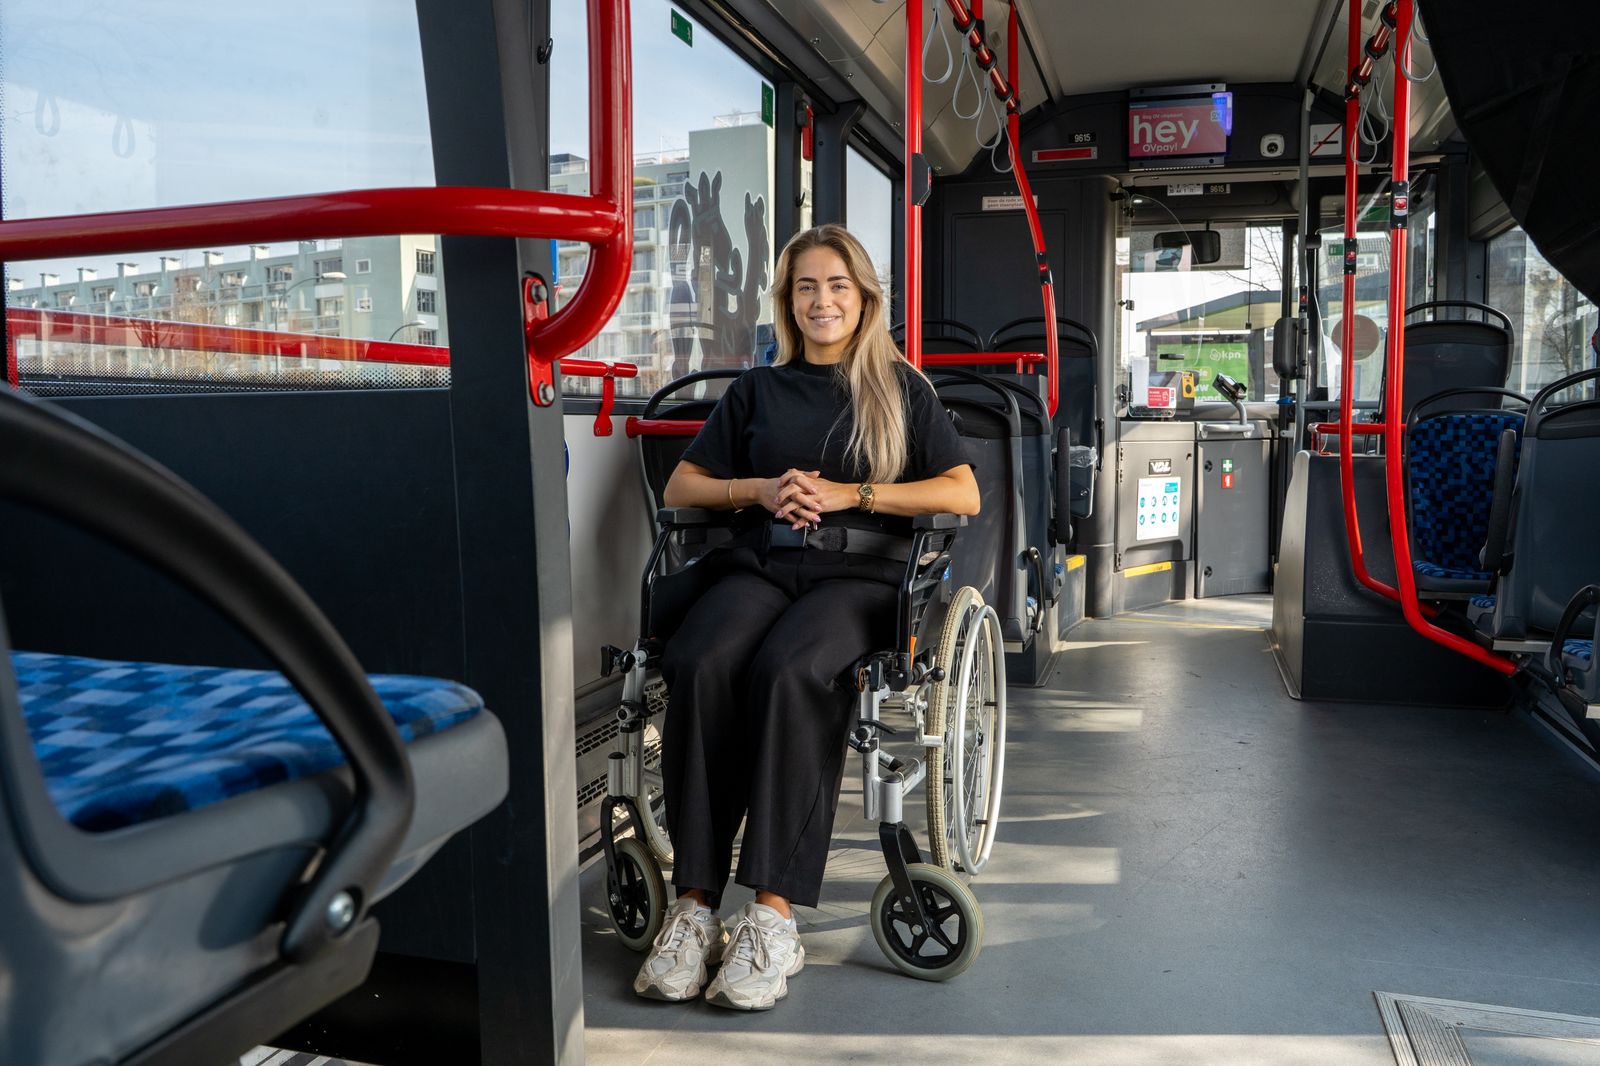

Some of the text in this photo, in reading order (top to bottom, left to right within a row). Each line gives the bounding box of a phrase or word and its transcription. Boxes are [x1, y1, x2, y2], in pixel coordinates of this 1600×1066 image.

[1133, 115, 1199, 149] hey
[1074, 133, 1091, 143] 9615
[1210, 184, 1225, 193] 9615
[1222, 350, 1241, 360] kpn
[1150, 461, 1171, 473] VDL
